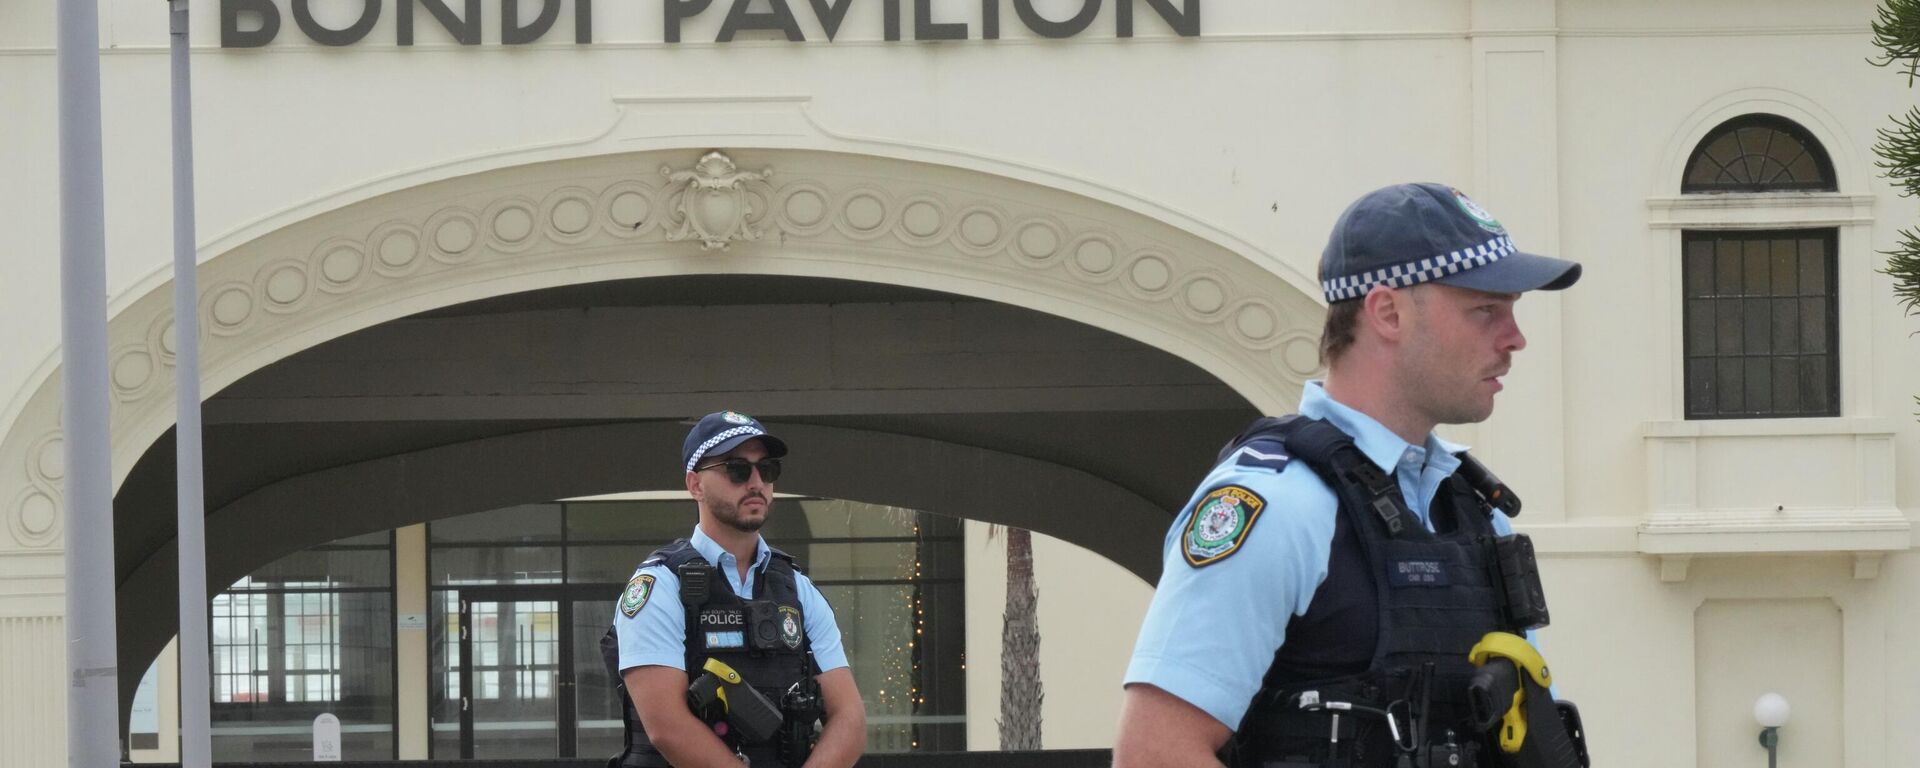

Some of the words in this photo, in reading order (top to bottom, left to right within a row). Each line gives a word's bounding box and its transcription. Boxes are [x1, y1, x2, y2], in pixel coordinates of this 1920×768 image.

[220, 0, 592, 48] BONDI
[664, 0, 1201, 43] PAVILION
[1230, 489, 1261, 509] POLICE
[1398, 562, 1440, 573] BUTTROSE
[700, 614, 744, 625] POLICE
